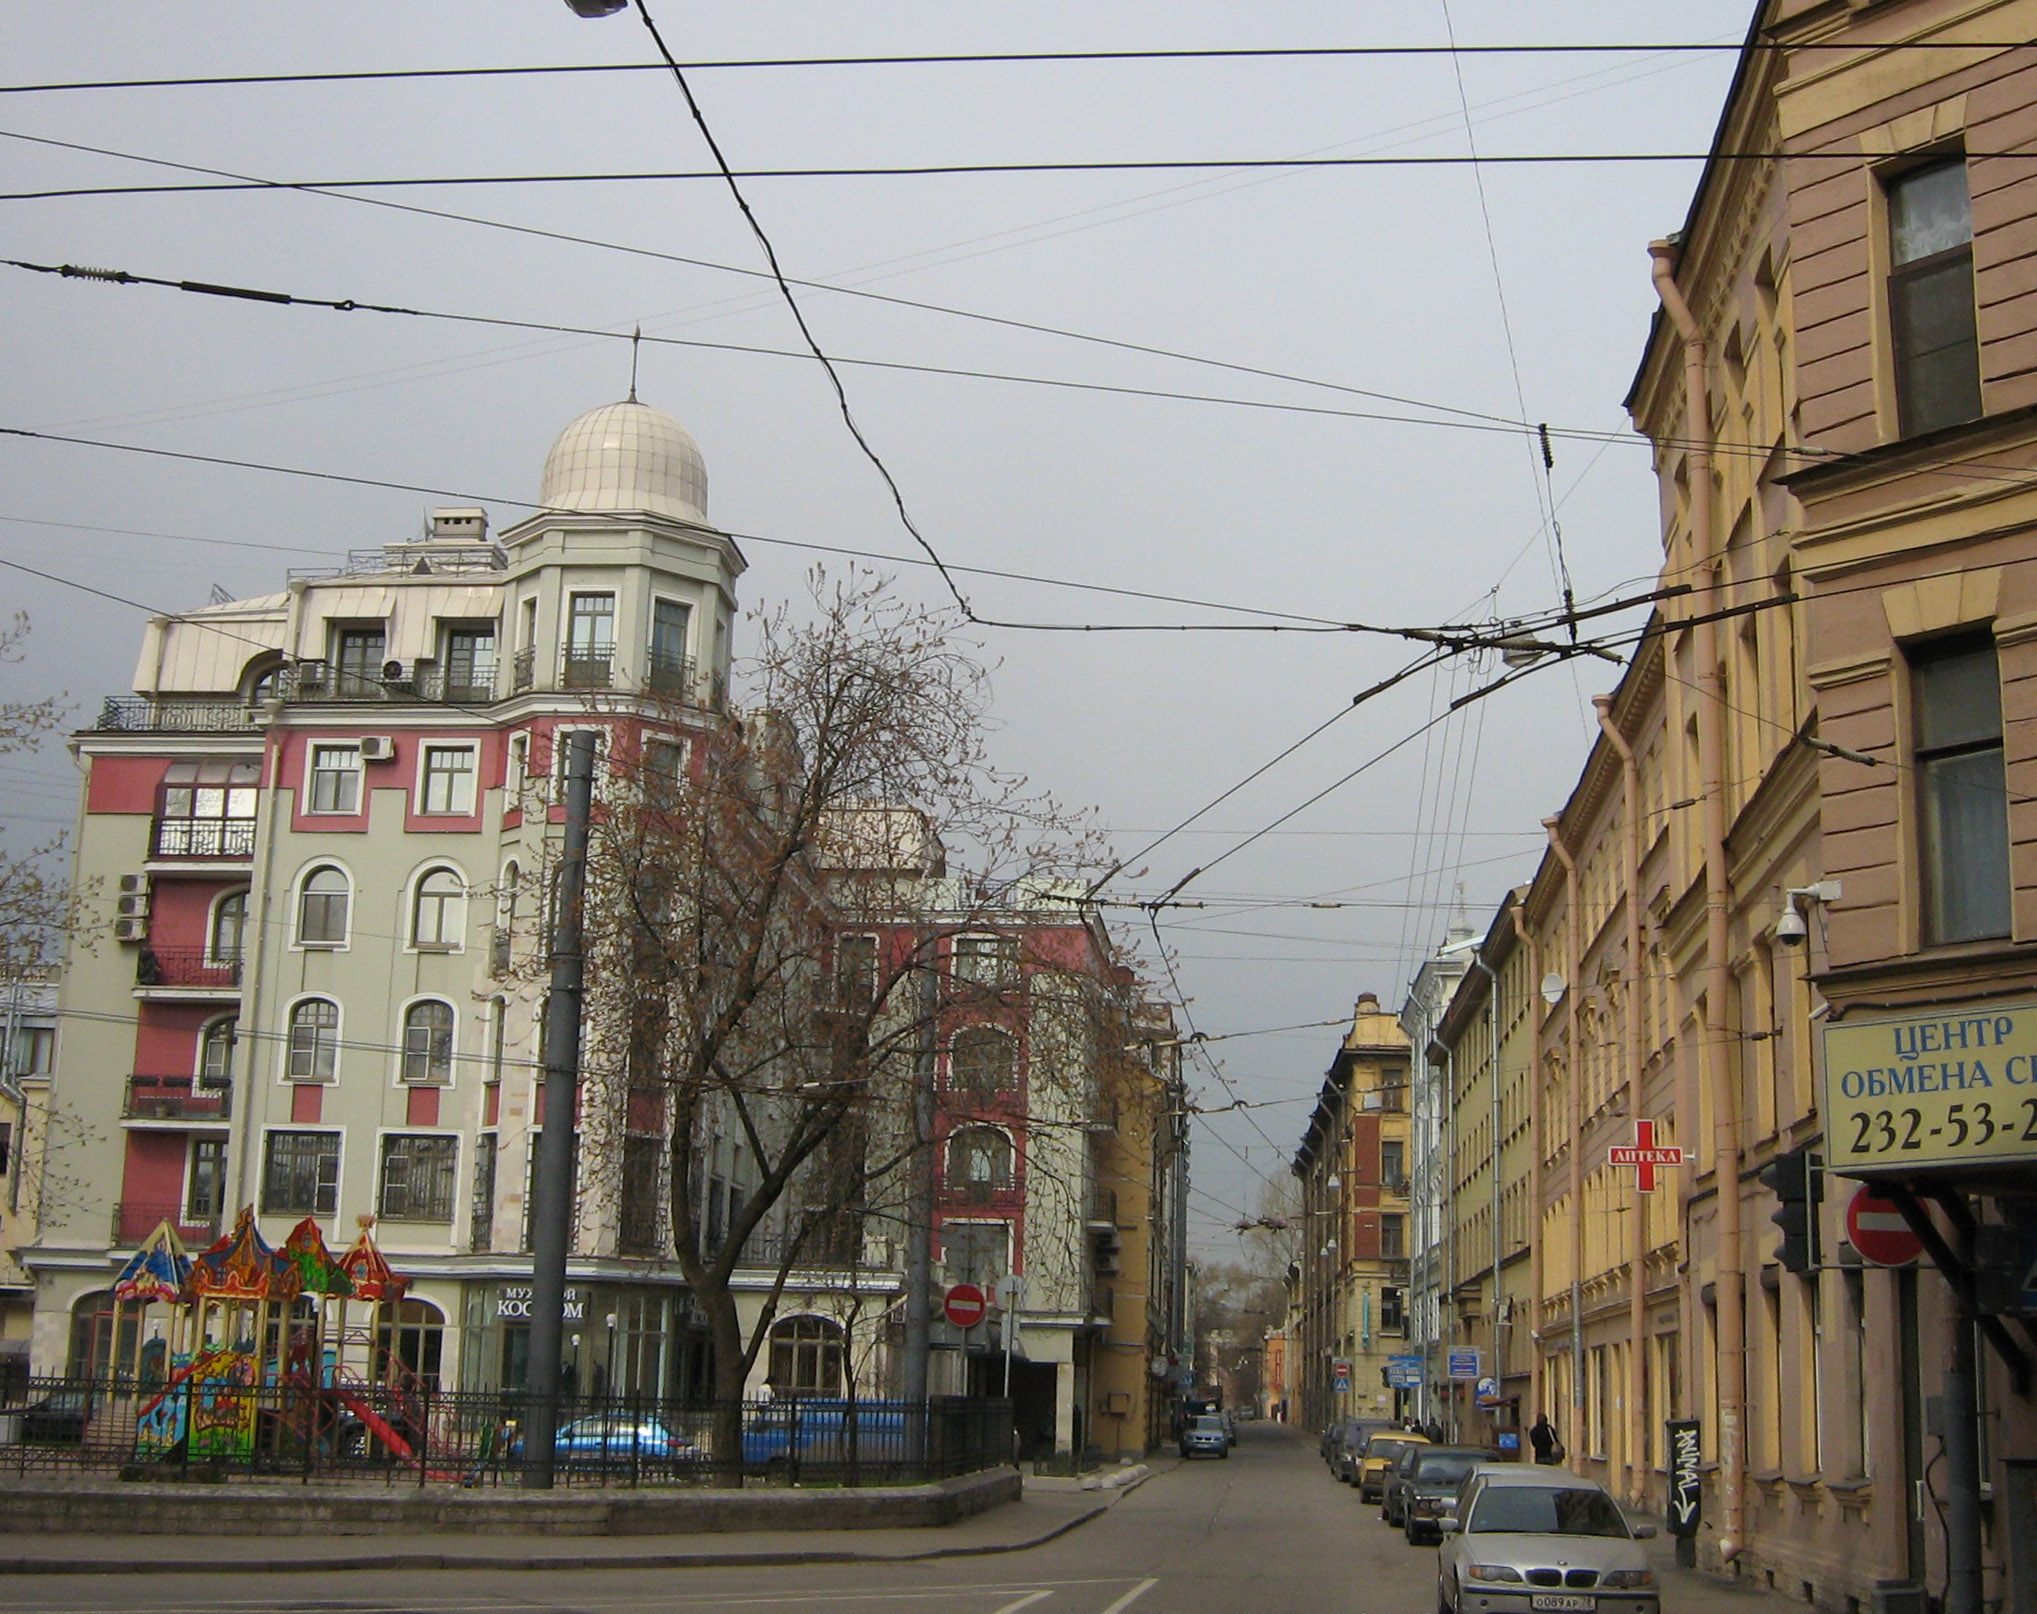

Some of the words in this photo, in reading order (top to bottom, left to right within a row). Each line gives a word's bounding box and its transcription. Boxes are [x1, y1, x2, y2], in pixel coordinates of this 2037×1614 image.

[1893, 1016, 2013, 1062] ЦЕНТР
[1841, 1060, 1993, 1098] ОБМЕНА
[1850, 1098, 2037, 1153] 232-53-2
[1614, 1150, 1678, 1163] АПТЕКА
